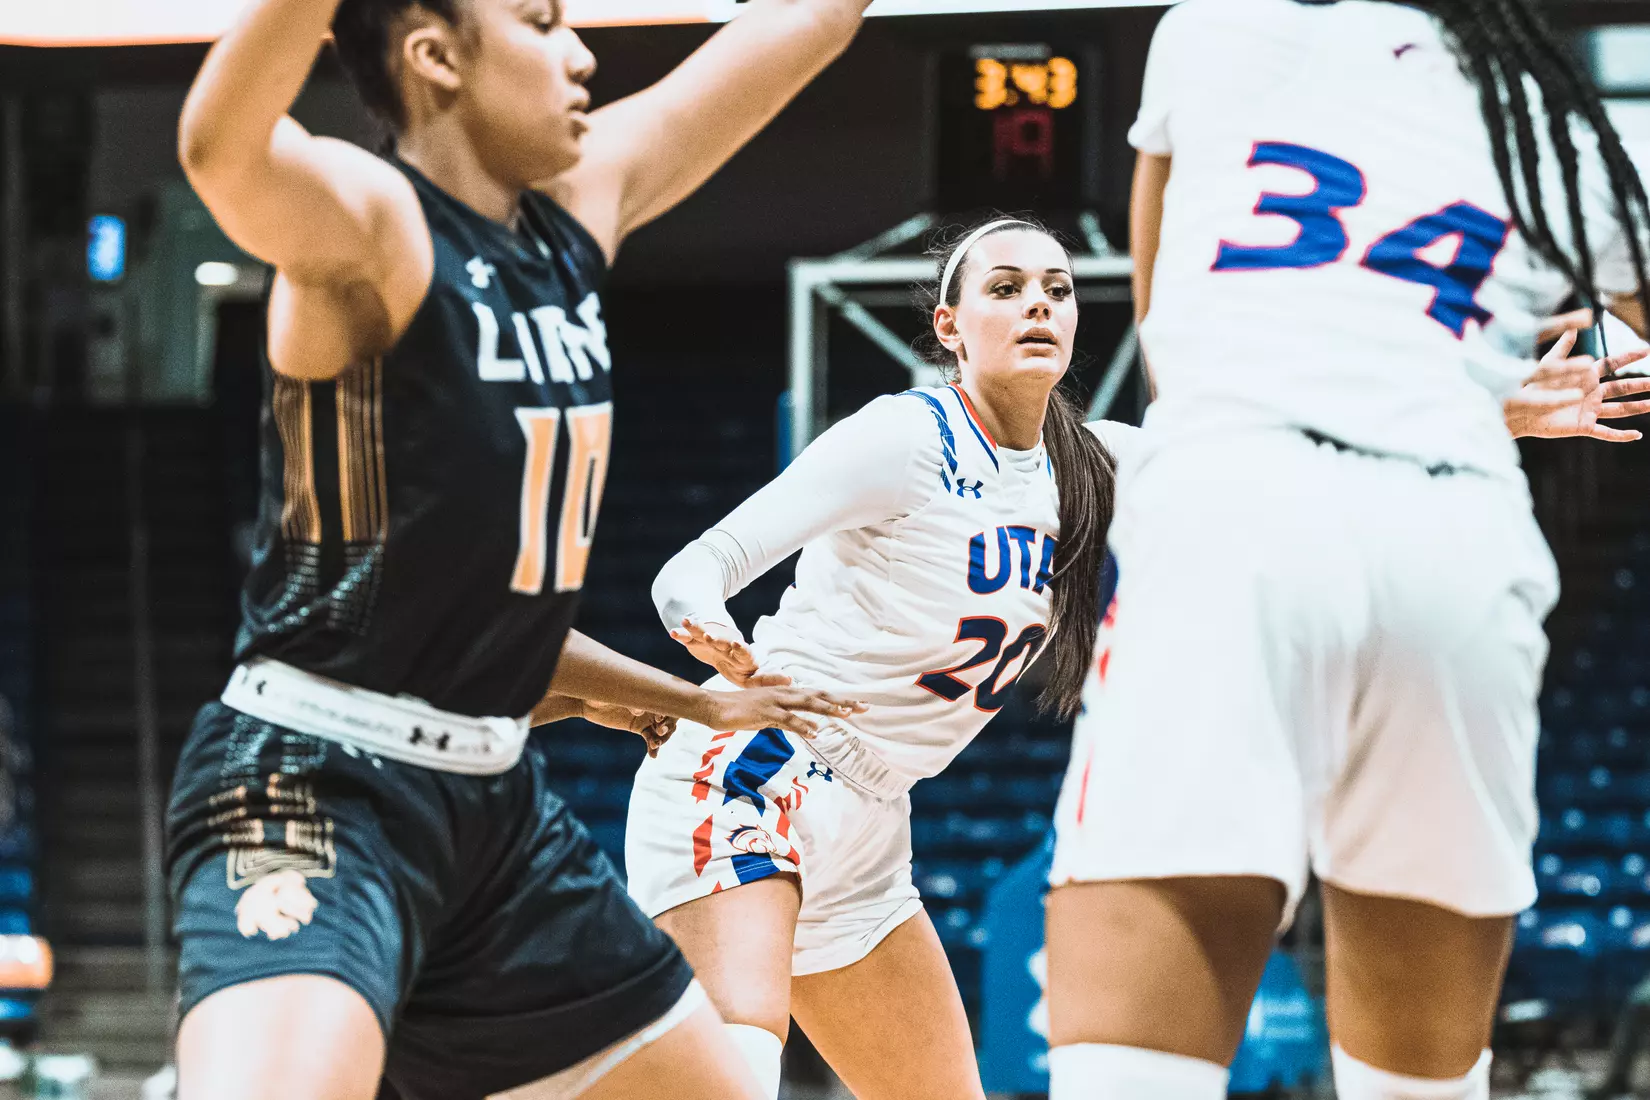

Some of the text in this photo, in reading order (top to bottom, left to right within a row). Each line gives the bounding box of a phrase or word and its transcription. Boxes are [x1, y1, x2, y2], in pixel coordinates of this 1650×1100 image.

[1210, 141, 1514, 340] 34
[509, 401, 613, 595] 10
[914, 615, 1049, 713] 20
